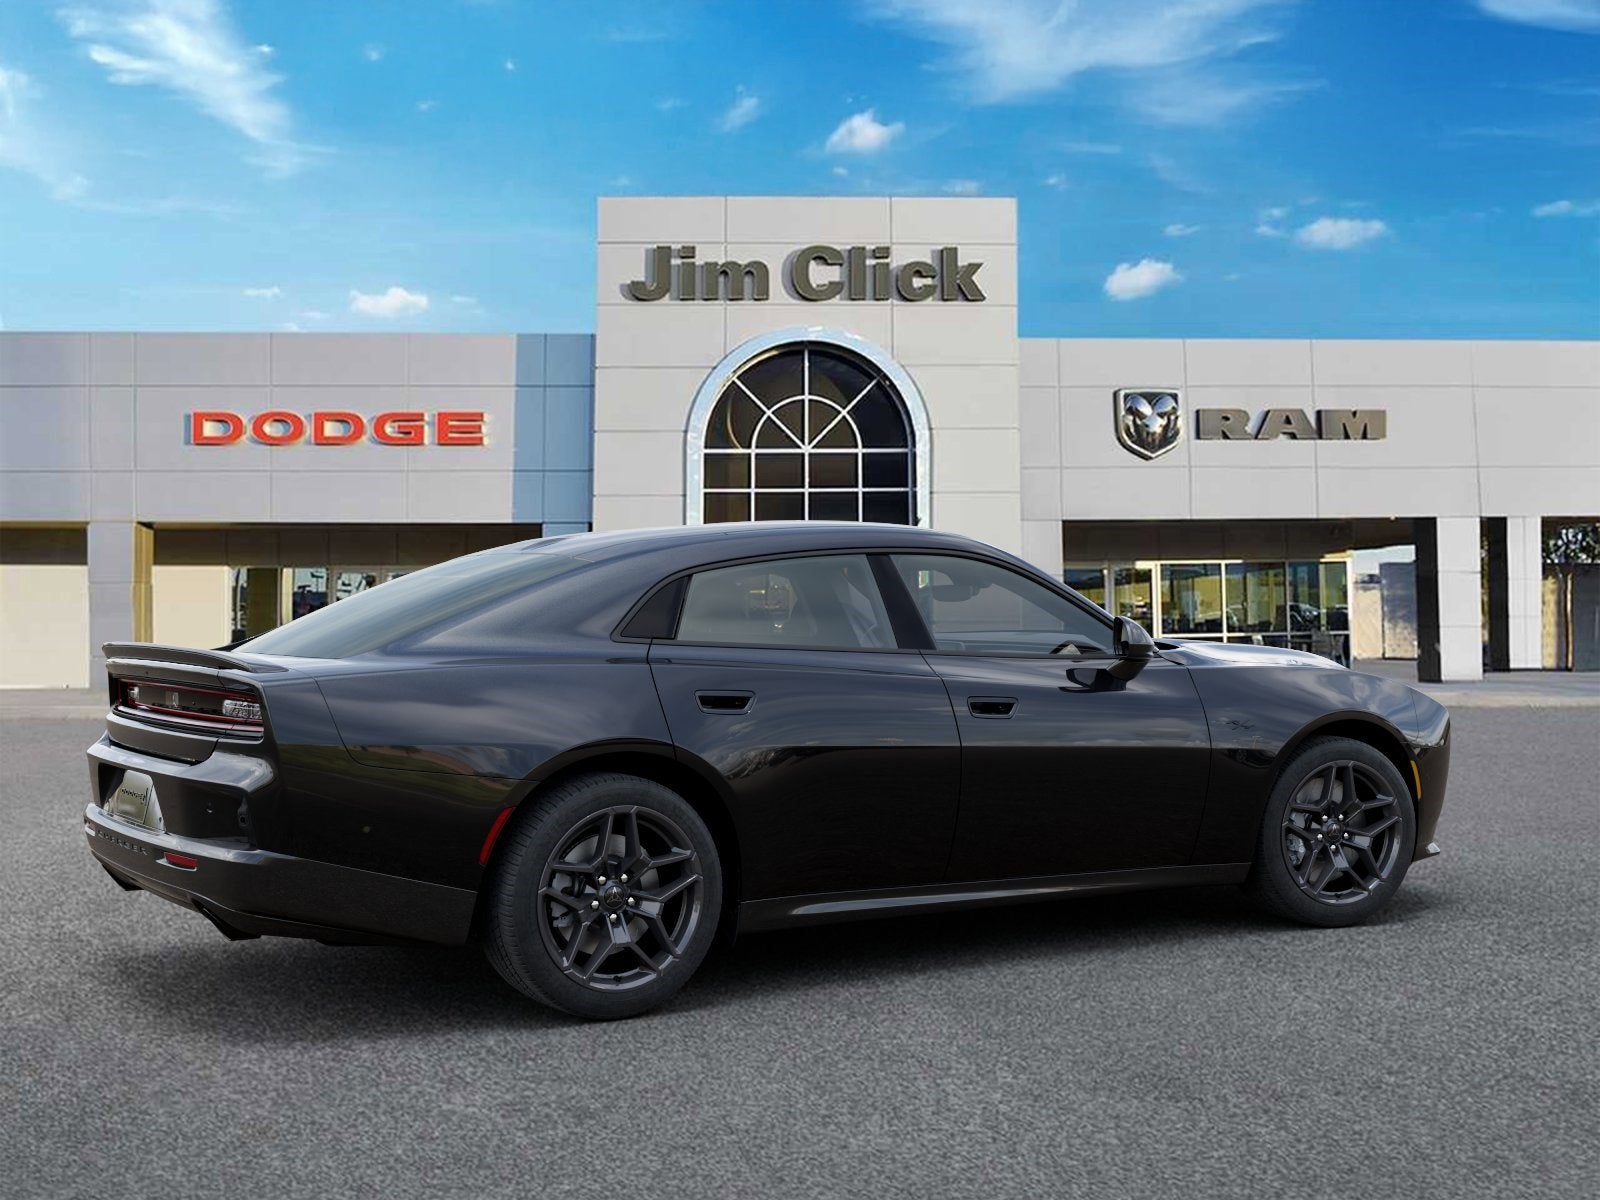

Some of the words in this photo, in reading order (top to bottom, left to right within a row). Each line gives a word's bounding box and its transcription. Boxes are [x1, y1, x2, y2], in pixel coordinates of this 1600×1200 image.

[628, 245, 769, 301] Jim
[791, 245, 985, 301] Click
[190, 410, 486, 446] DODGE
[1195, 408, 1387, 440] RAM
